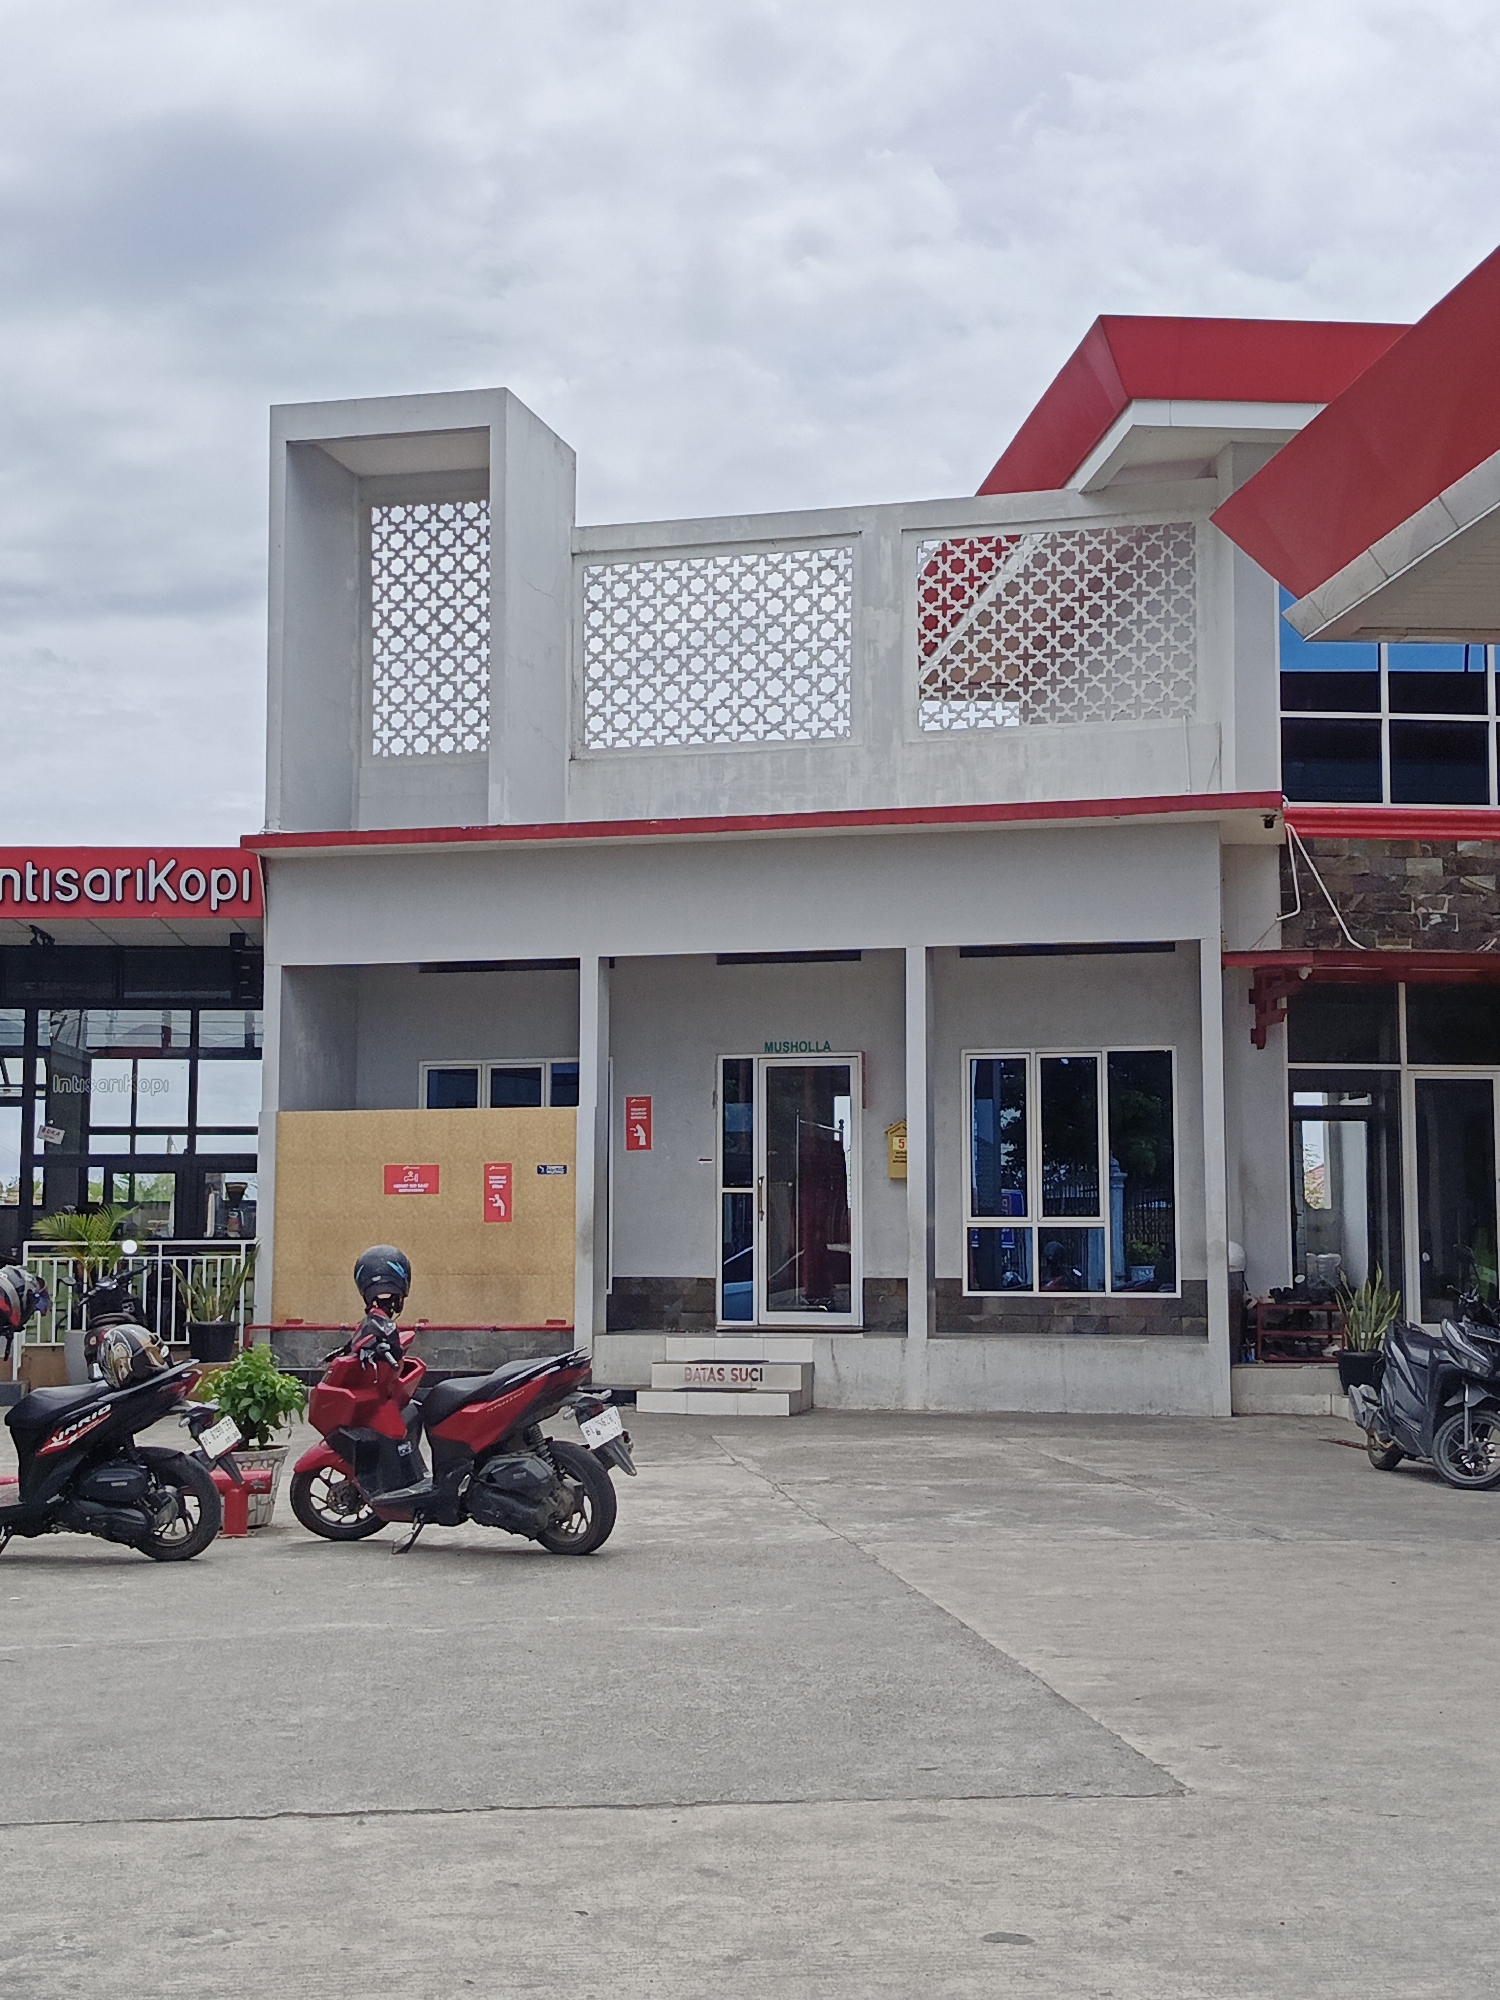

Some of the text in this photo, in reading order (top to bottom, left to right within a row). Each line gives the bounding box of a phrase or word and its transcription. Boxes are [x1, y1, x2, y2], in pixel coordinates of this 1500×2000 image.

[764, 1040, 832, 1053] MUSHOLLA
[684, 1367, 764, 1383] BATAS SUCI
[51, 1403, 112, 1443] VARIO
